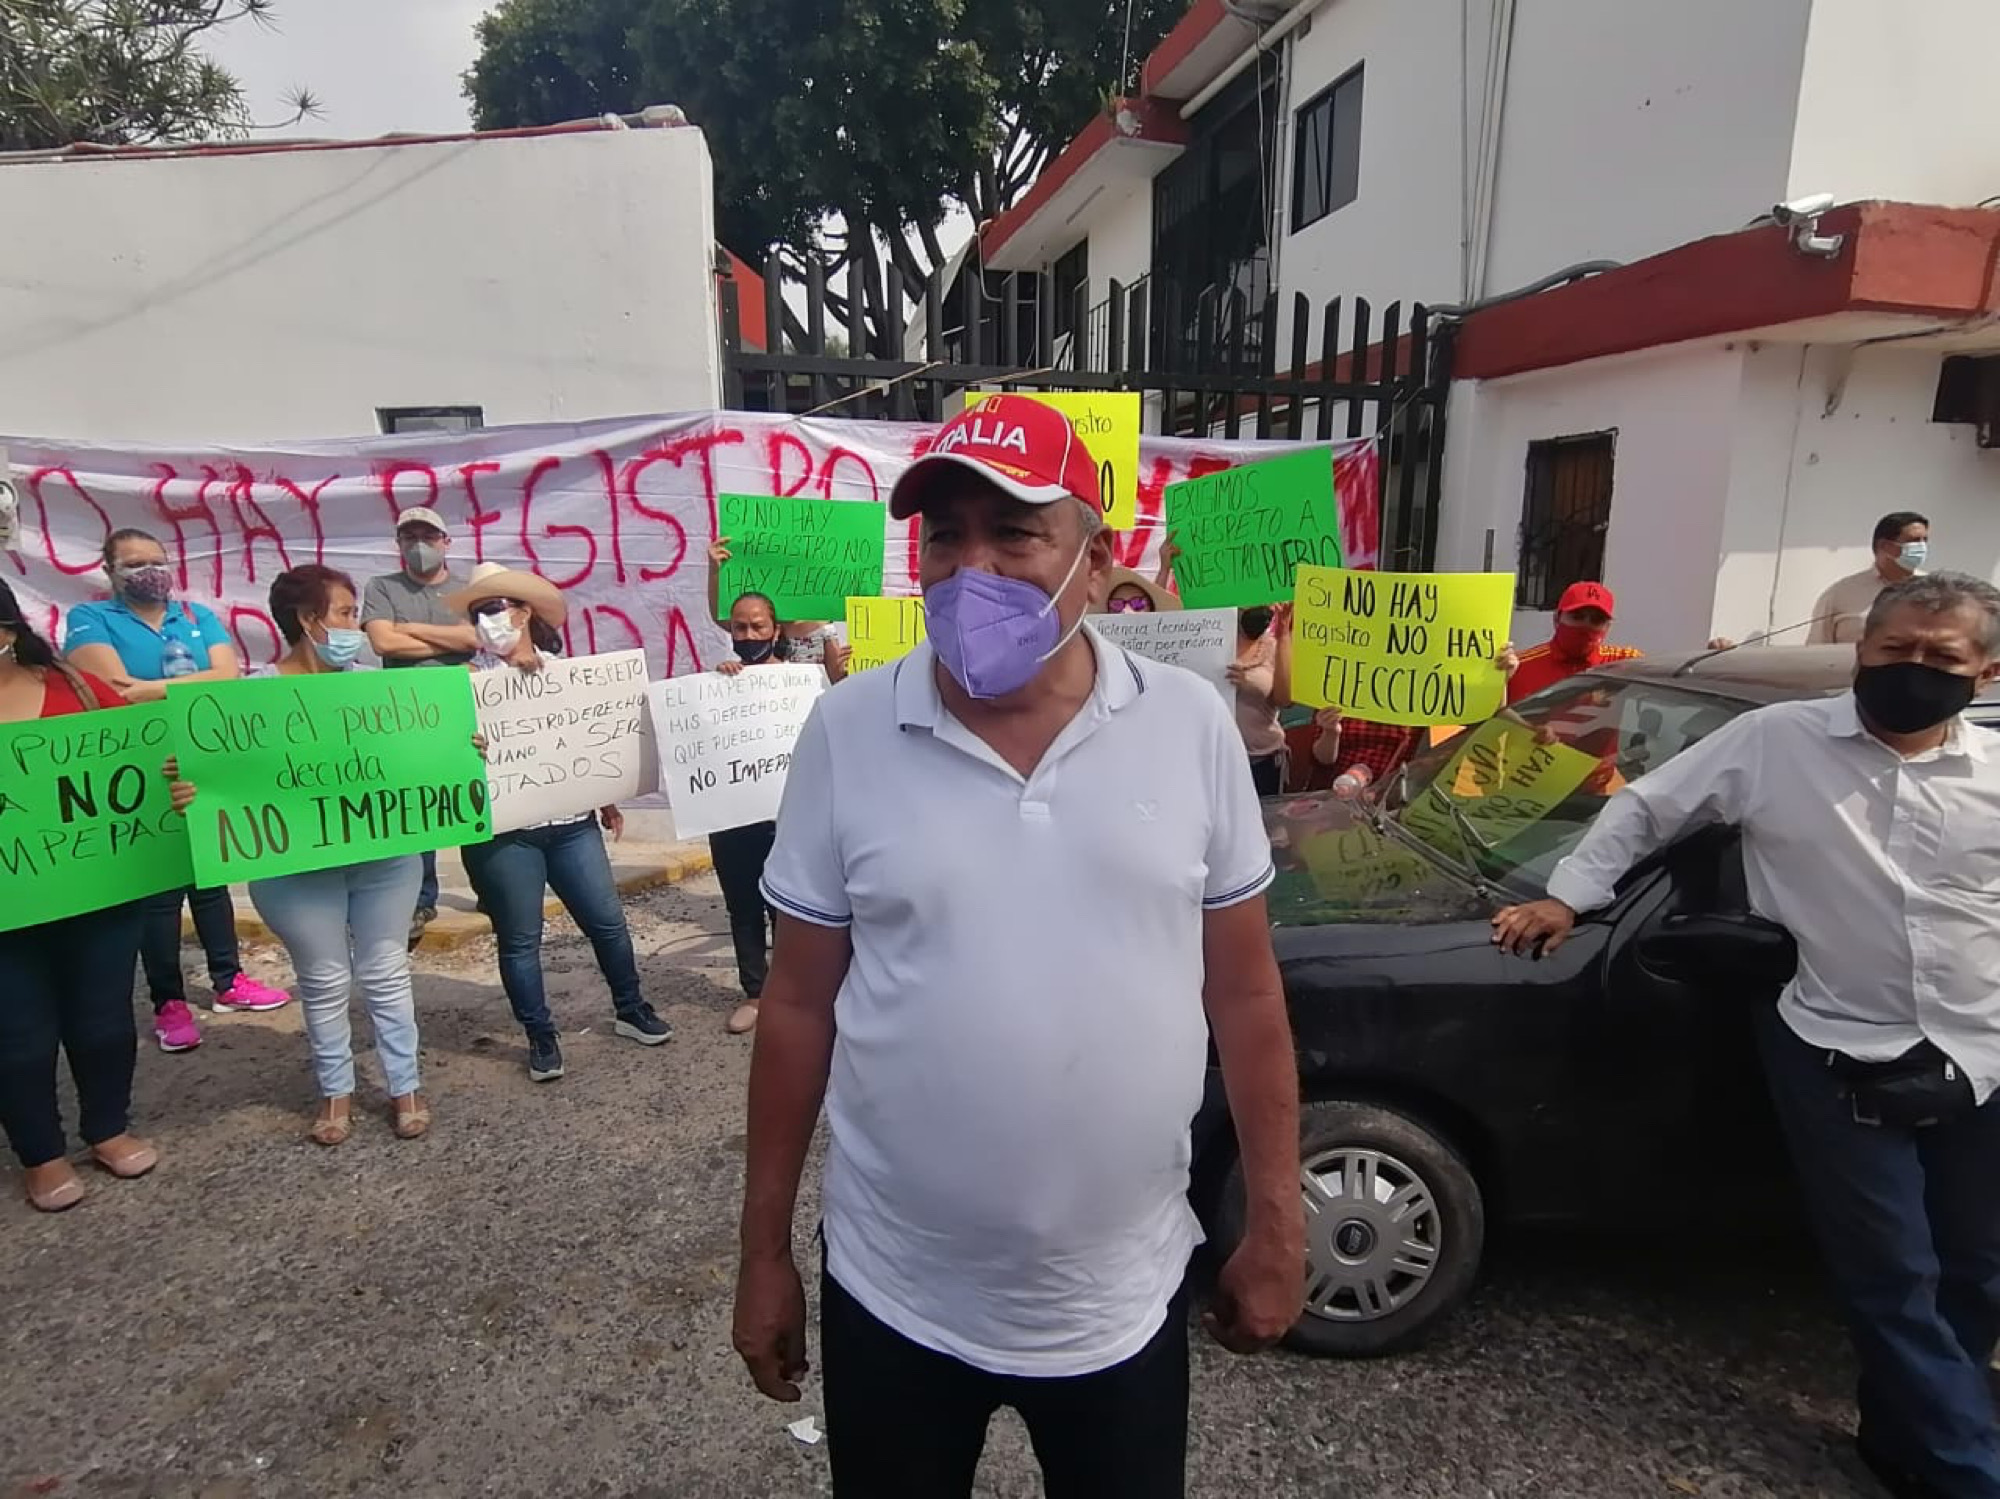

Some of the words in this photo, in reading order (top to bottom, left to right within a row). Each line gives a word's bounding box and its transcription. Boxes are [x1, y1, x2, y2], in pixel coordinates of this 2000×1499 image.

[755, 500, 781, 529] NO
[791, 503, 834, 532] HAY
[1189, 508, 1284, 547] RESPETO
[1299, 499, 1319, 532] A
[743, 532, 839, 560] REGISTRO
[843, 538, 871, 563] NO
[726, 566, 772, 599] HAY
[1343, 575, 1376, 618] NO
[1388, 582, 1438, 623] HAY
[1302, 618, 1371, 647] registro
[1386, 623, 1428, 655] NO
[1447, 627, 1495, 660] HAY
[472, 672, 563, 709] IGIMOS
[569, 658, 643, 686] RESPETO
[665, 687, 687, 708] EL
[1322, 655, 1466, 718] ELECCIÓN
[187, 692, 267, 755] Que
[285, 688, 315, 743] el
[337, 687, 441, 746] pueblo
[555, 736, 568, 750] A
[585, 718, 646, 748] SER
[11, 718, 168, 775] PUEBLO
[275, 747, 386, 790] decida
[674, 742, 705, 764] QUE
[712, 728, 765, 750] PUEBLO
[57, 764, 146, 823] NO
[486, 751, 623, 801] OTADOS
[690, 768, 717, 794] NO
[727, 753, 792, 785] IMPEPA
[0, 817, 183, 876] MPEPAC
[217, 803, 290, 864] NO
